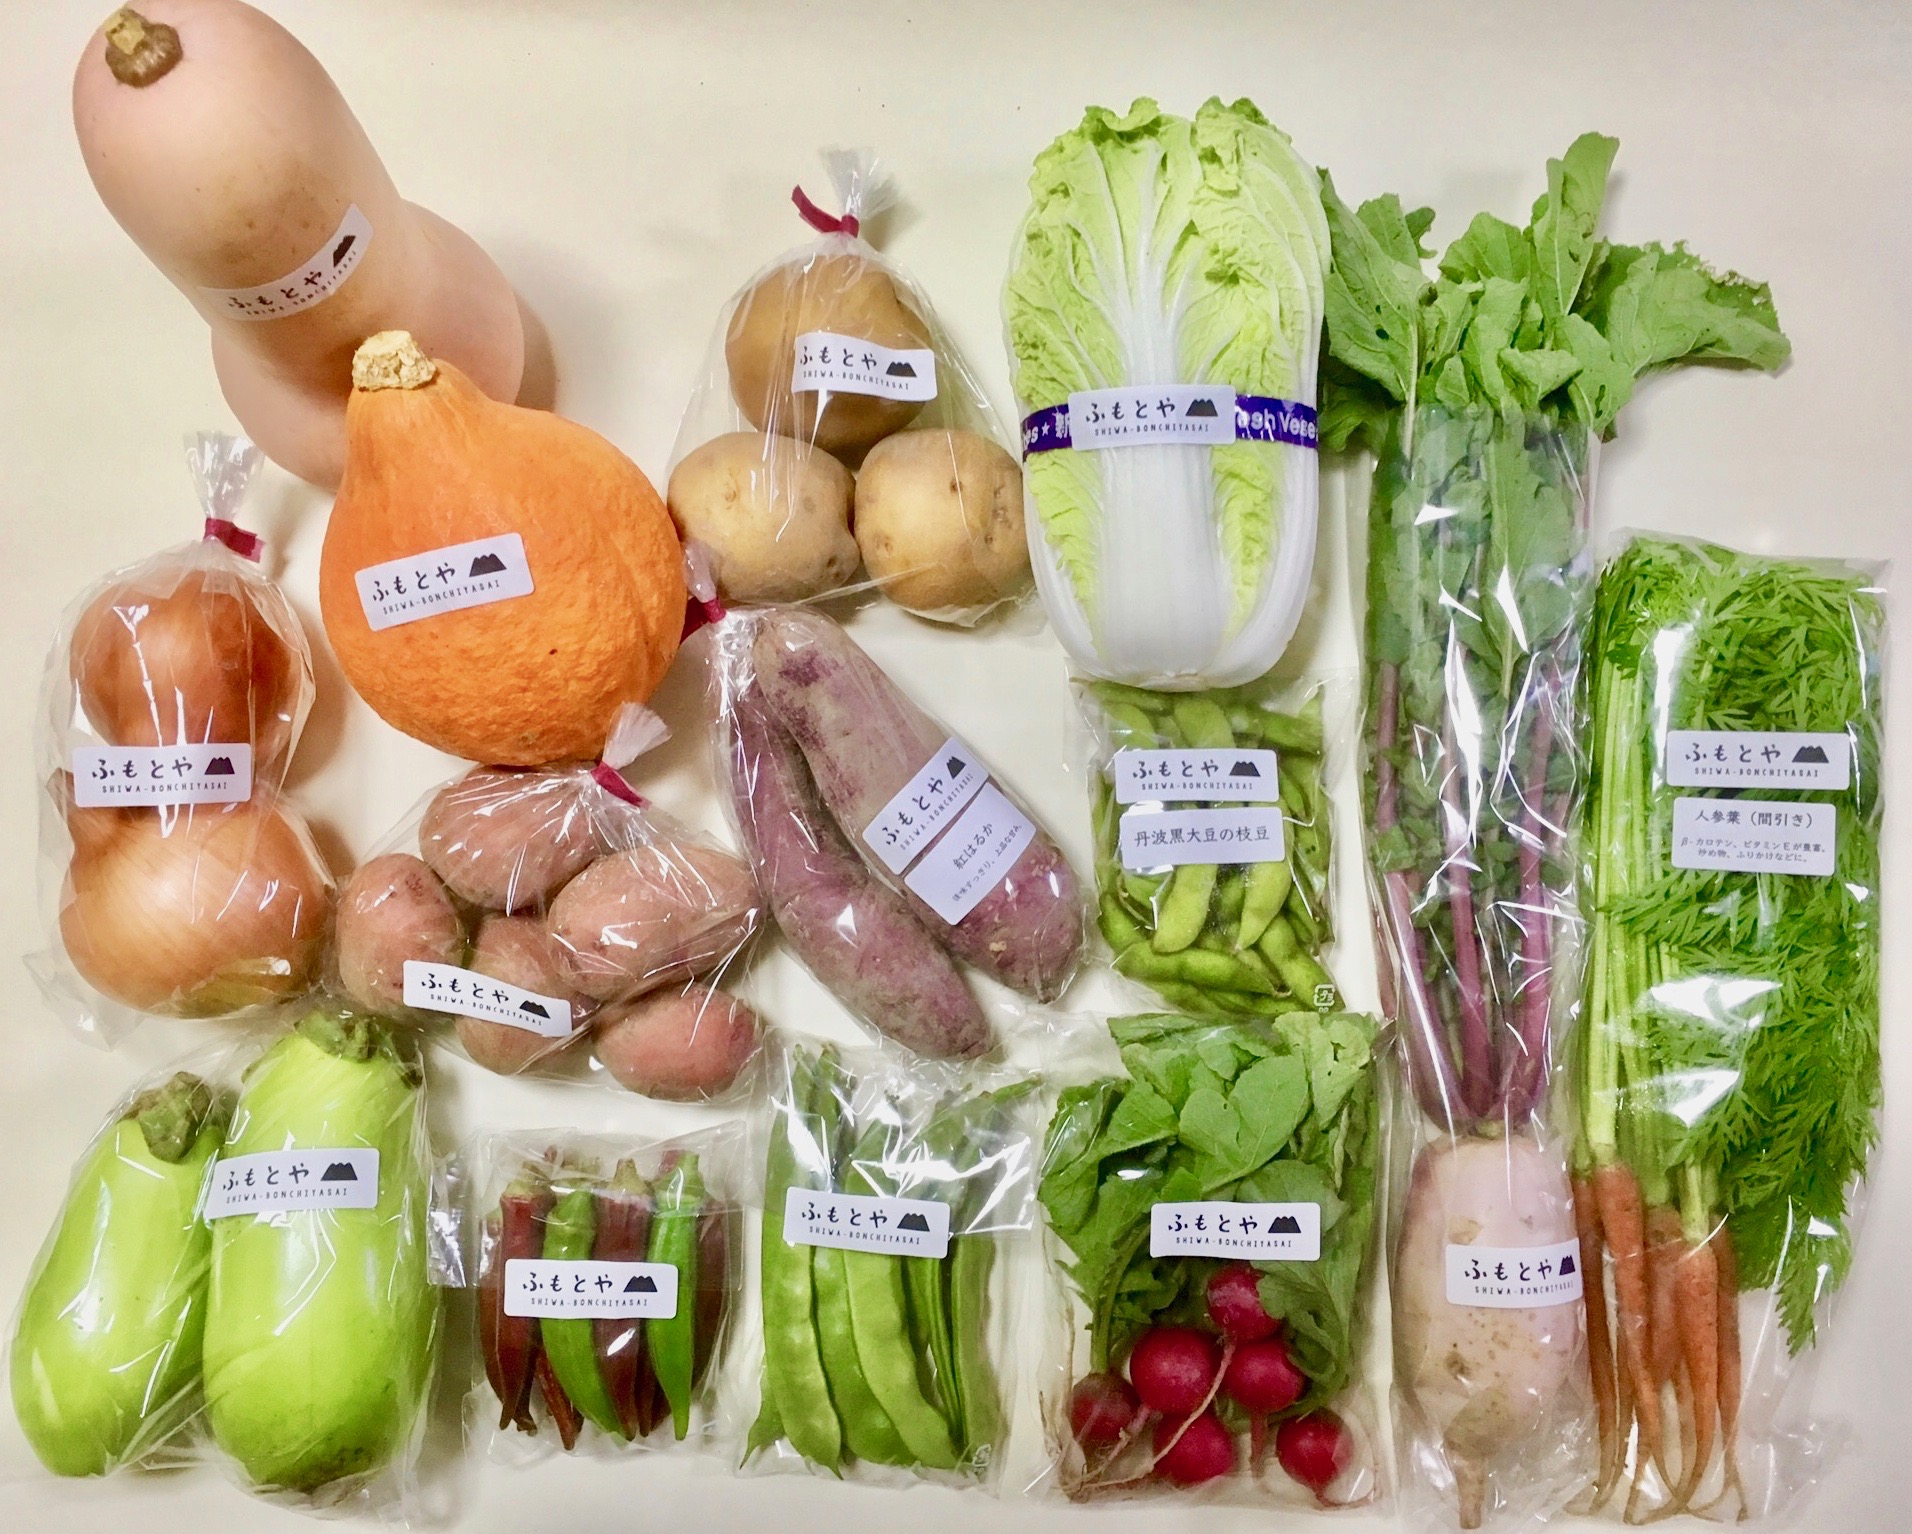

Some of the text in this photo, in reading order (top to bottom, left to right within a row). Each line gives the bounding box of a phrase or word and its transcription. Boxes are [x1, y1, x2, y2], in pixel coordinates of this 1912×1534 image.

[227, 271, 322, 309] ふもとや
[800, 346, 877, 371] ふもとや
[803, 371, 909, 390] SHIWA-BONCHIYASAI
[1086, 397, 1176, 424] ふもとや
[1095, 424, 1209, 437] SHIWA-BONCHIYASAI
[373, 562, 456, 602] ふもとや
[383, 579, 500, 615] SHIWA-BONCHIYASAI
[1685, 743, 1781, 763] ふもとや
[92, 756, 193, 780] ふもとや
[1132, 759, 1219, 779] ふもとや
[1694, 767, 1819, 778] SHIWA-BONCHIYASAI
[102, 782, 228, 793] SHIWA-BONCHIYASAI
[1141, 782, 1253, 790] SHIWA-BONCHIYASAI
[882, 777, 943, 846] ふもとや
[900, 773, 974, 851] SHIWA-BONCHIYASAI
[952, 823, 993, 871] 紅はるか
[1134, 825, 1270, 848] 丹波黒大豆の枝豆
[421, 973, 509, 1004] ふもとや
[430, 993, 543, 1026] SHIWA-BONCHIYASAI
[222, 1163, 309, 1190] ふもとや
[226, 1188, 348, 1204] SHIWA-BONCHIYASAI
[801, 1202, 888, 1229] ふもとや
[1168, 1214, 1258, 1234] ふもとや
[809, 1226, 921, 1245] SHIWA-BONCHIYASAI
[1176, 1237, 1292, 1248] SHIWA-BONCHIYASAI
[1464, 1259, 1552, 1281] ふもとや
[523, 1272, 613, 1293] ふもとや
[531, 1297, 648, 1307] SHIWA-BONCHIYASAI
